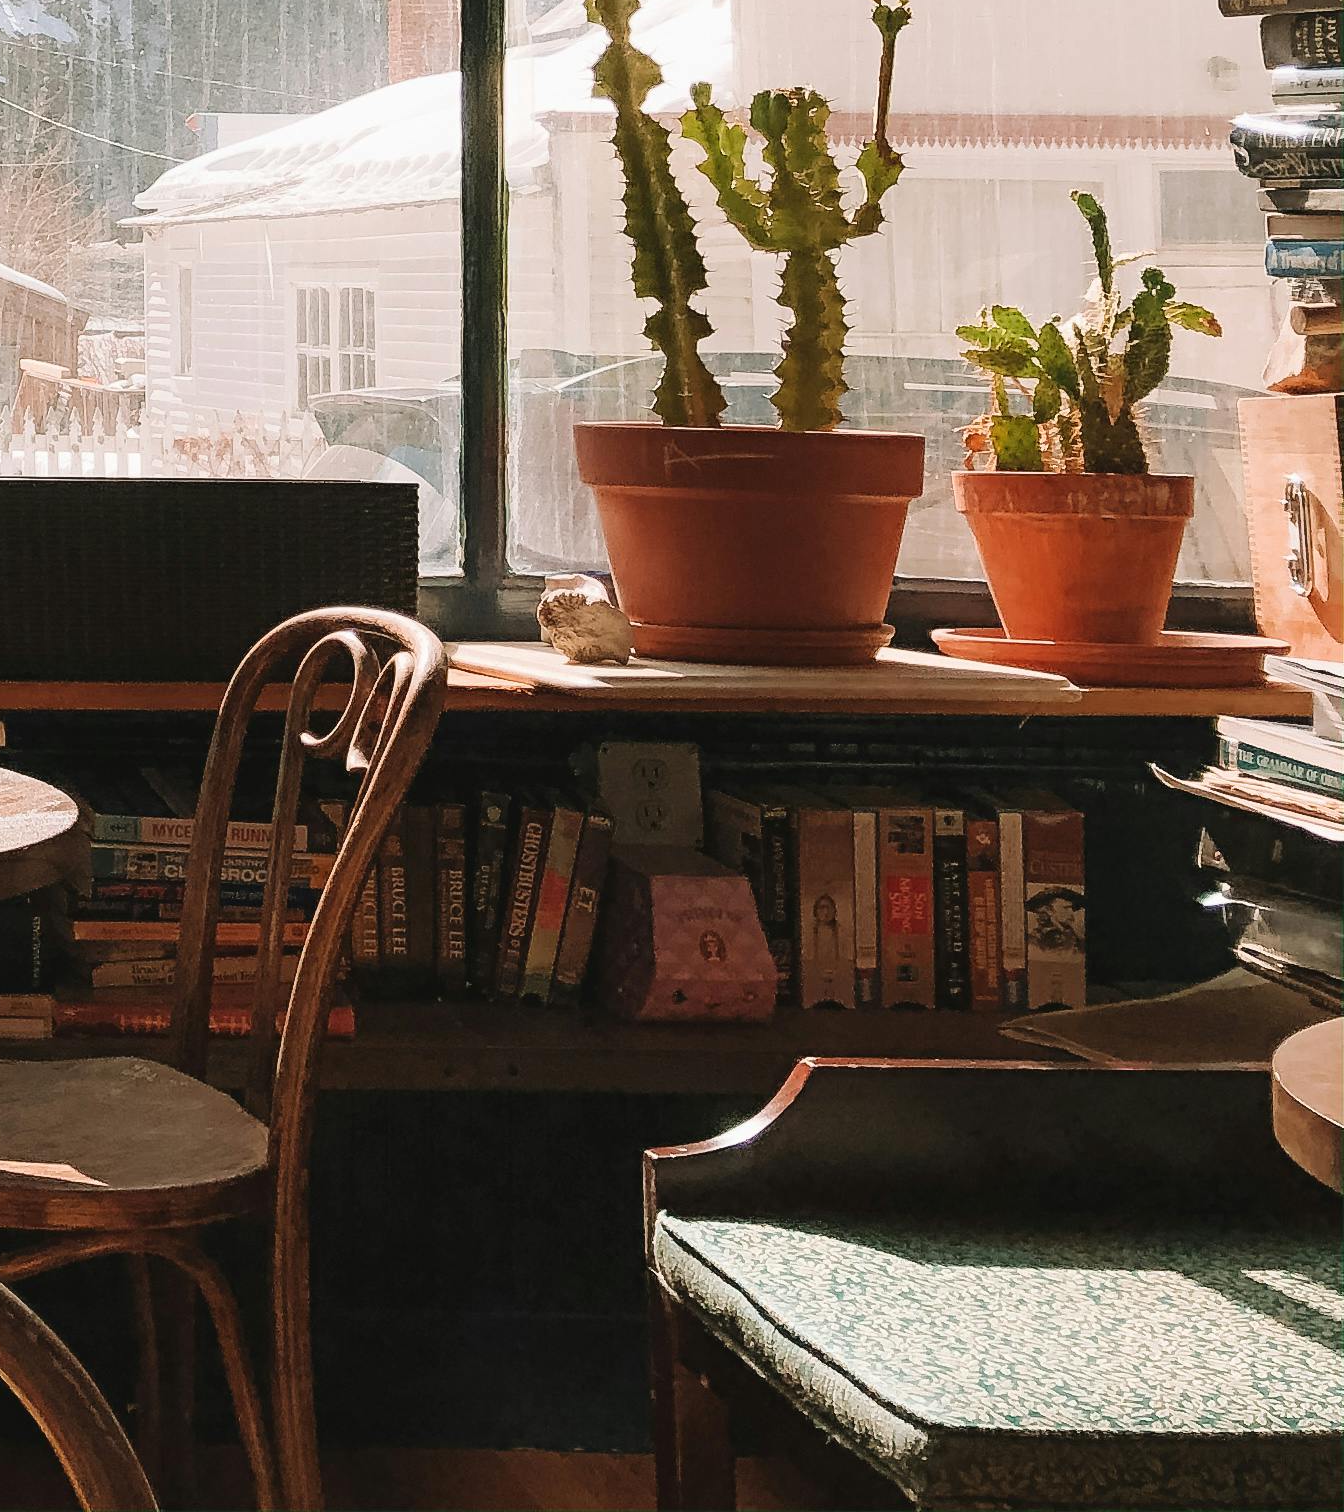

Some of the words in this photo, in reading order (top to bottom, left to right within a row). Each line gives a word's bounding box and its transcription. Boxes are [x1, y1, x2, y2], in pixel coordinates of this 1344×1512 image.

[1314, 15, 1328, 65] History
[1327, 16, 1339, 42] Art
[1316, 77, 1344, 88] AME
[1238, 748, 1255, 764] THE
[1256, 753, 1305, 779] GRAMMAR
[1305, 769, 1318, 782] OF
[151, 822, 192, 839] MYCE
[230, 828, 273, 844] RUNN
[223, 857, 266, 868] OUNTRY
[508, 822, 544, 938] GHOSTBUSTERS
[390, 866, 407, 926] BRUCE
[448, 868, 465, 931] BRUCE
[912, 892, 927, 921] SON
[391, 926, 408, 956] LEE
[449, 930, 466, 961] LEE
